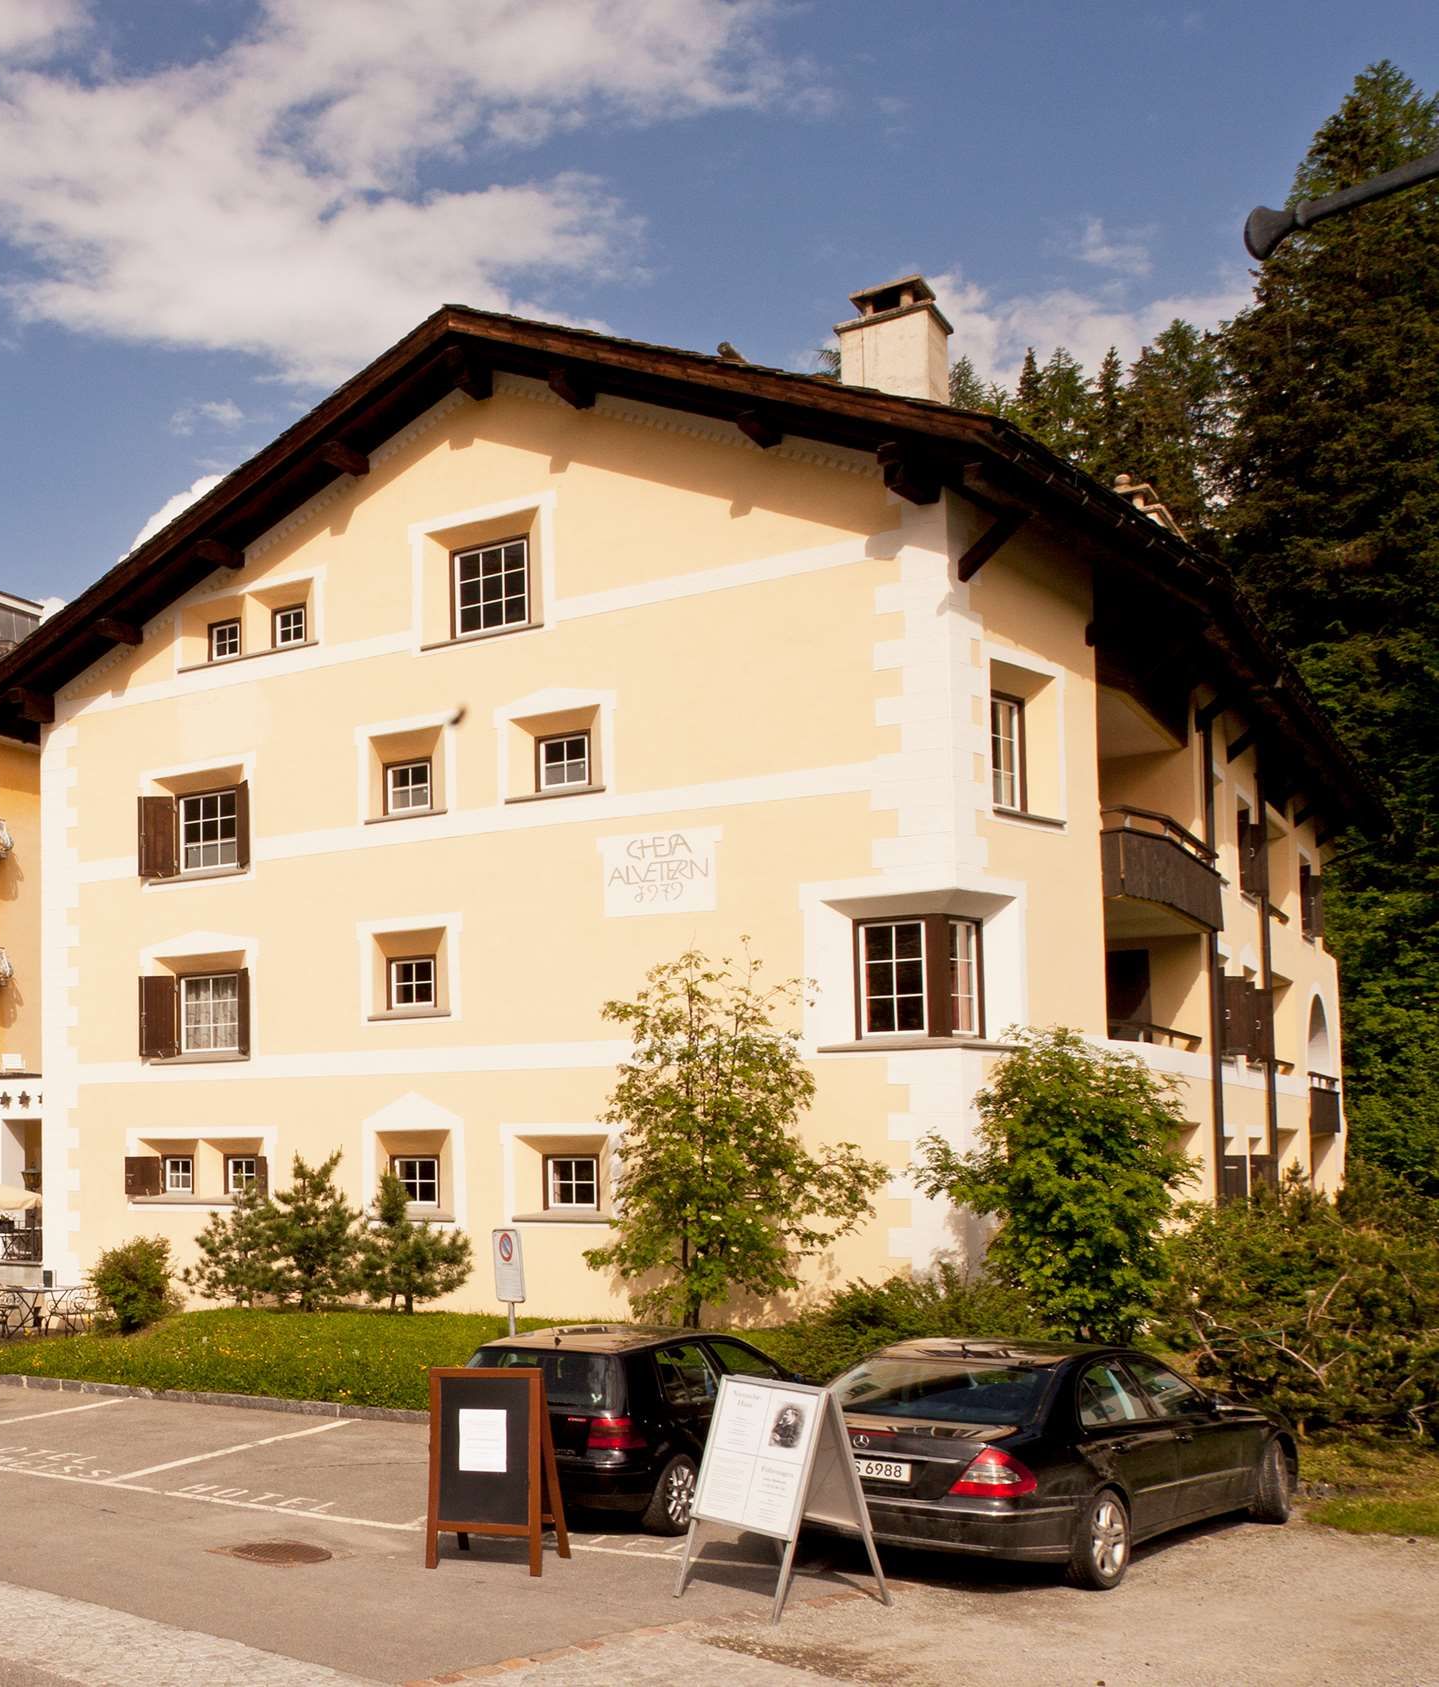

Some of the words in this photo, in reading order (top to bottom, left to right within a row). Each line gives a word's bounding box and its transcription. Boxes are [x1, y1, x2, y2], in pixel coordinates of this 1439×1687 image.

[626, 833, 693, 860] CHESA
[866, 1462, 902, 1478] 6988
[178, 1483, 336, 1513] HOTEL
